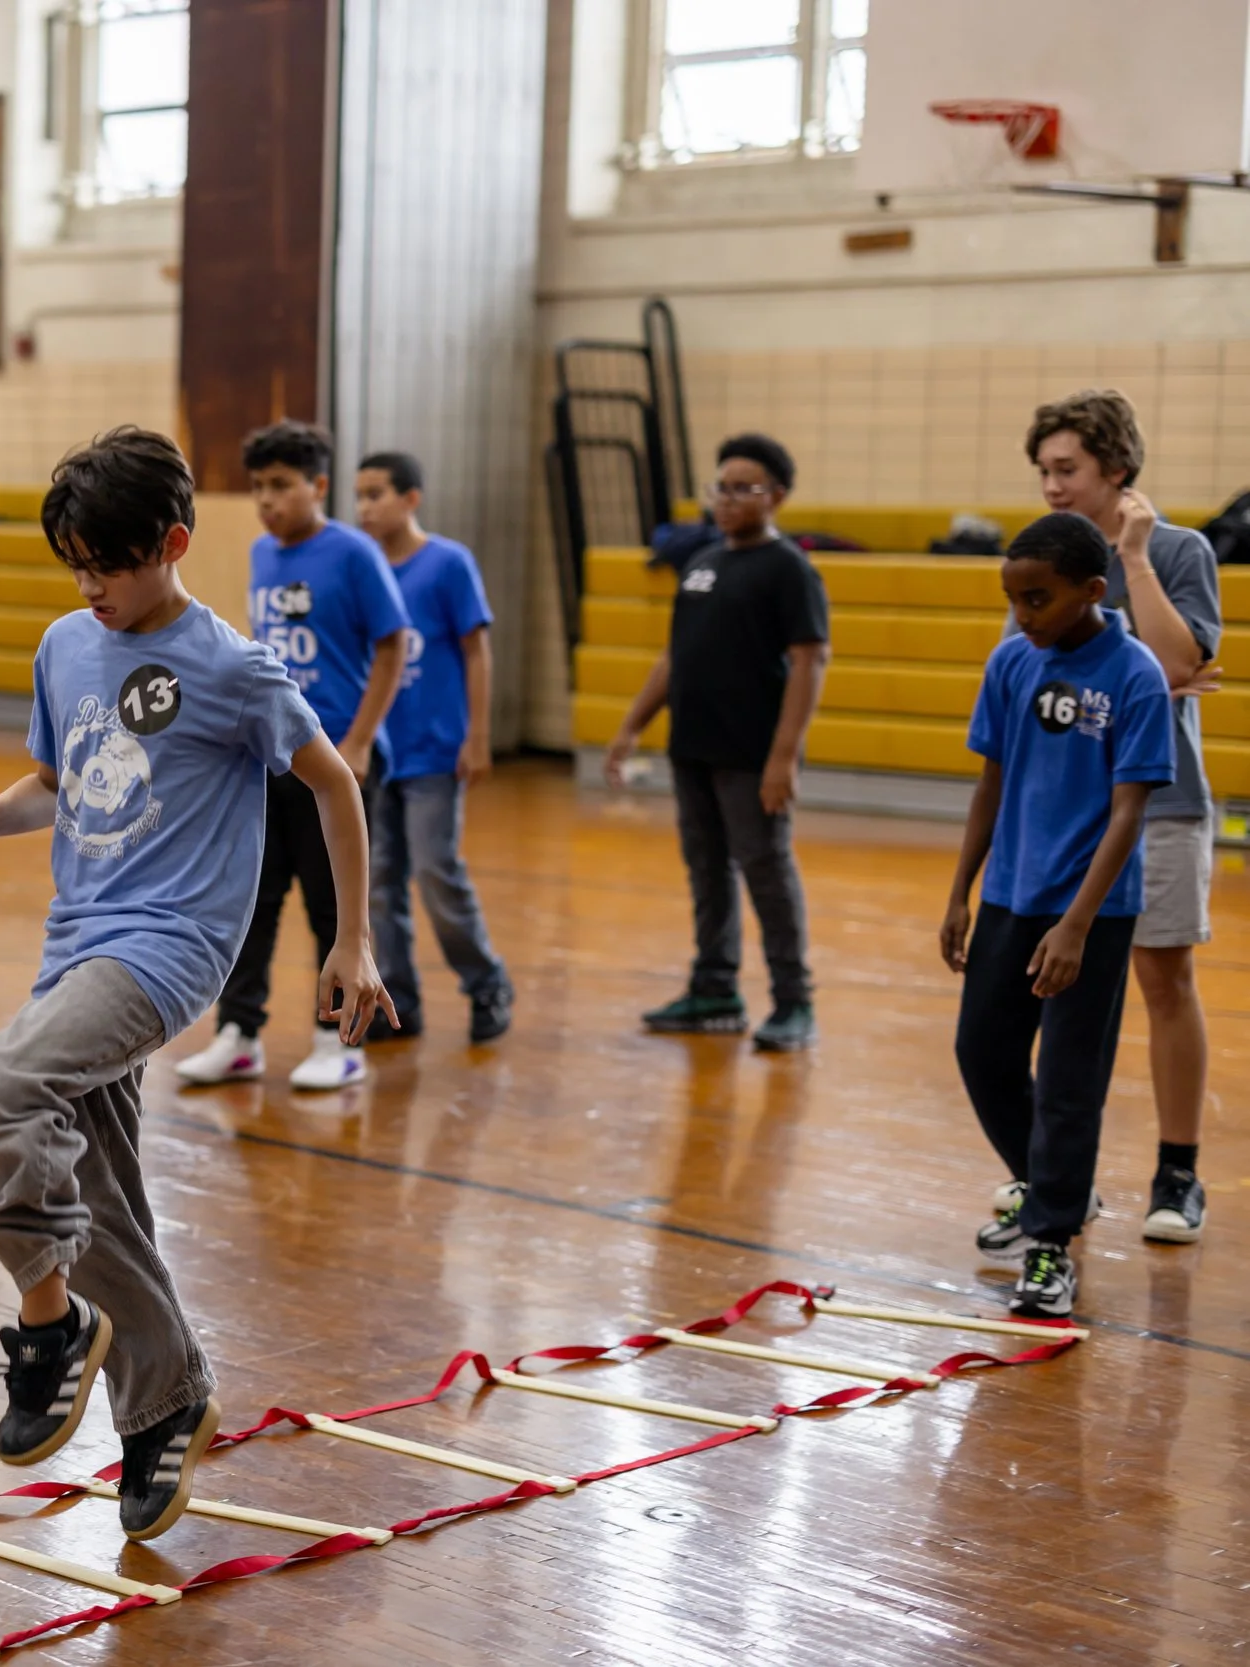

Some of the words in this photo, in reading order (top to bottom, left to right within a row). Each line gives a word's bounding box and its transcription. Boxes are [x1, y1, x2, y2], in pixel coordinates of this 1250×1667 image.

[268, 626, 318, 665] 50
[124, 677, 176, 722] 13
[1038, 690, 1077, 725] 16
[1081, 688, 1112, 712] MS
[1095, 711, 1113, 729] 5
